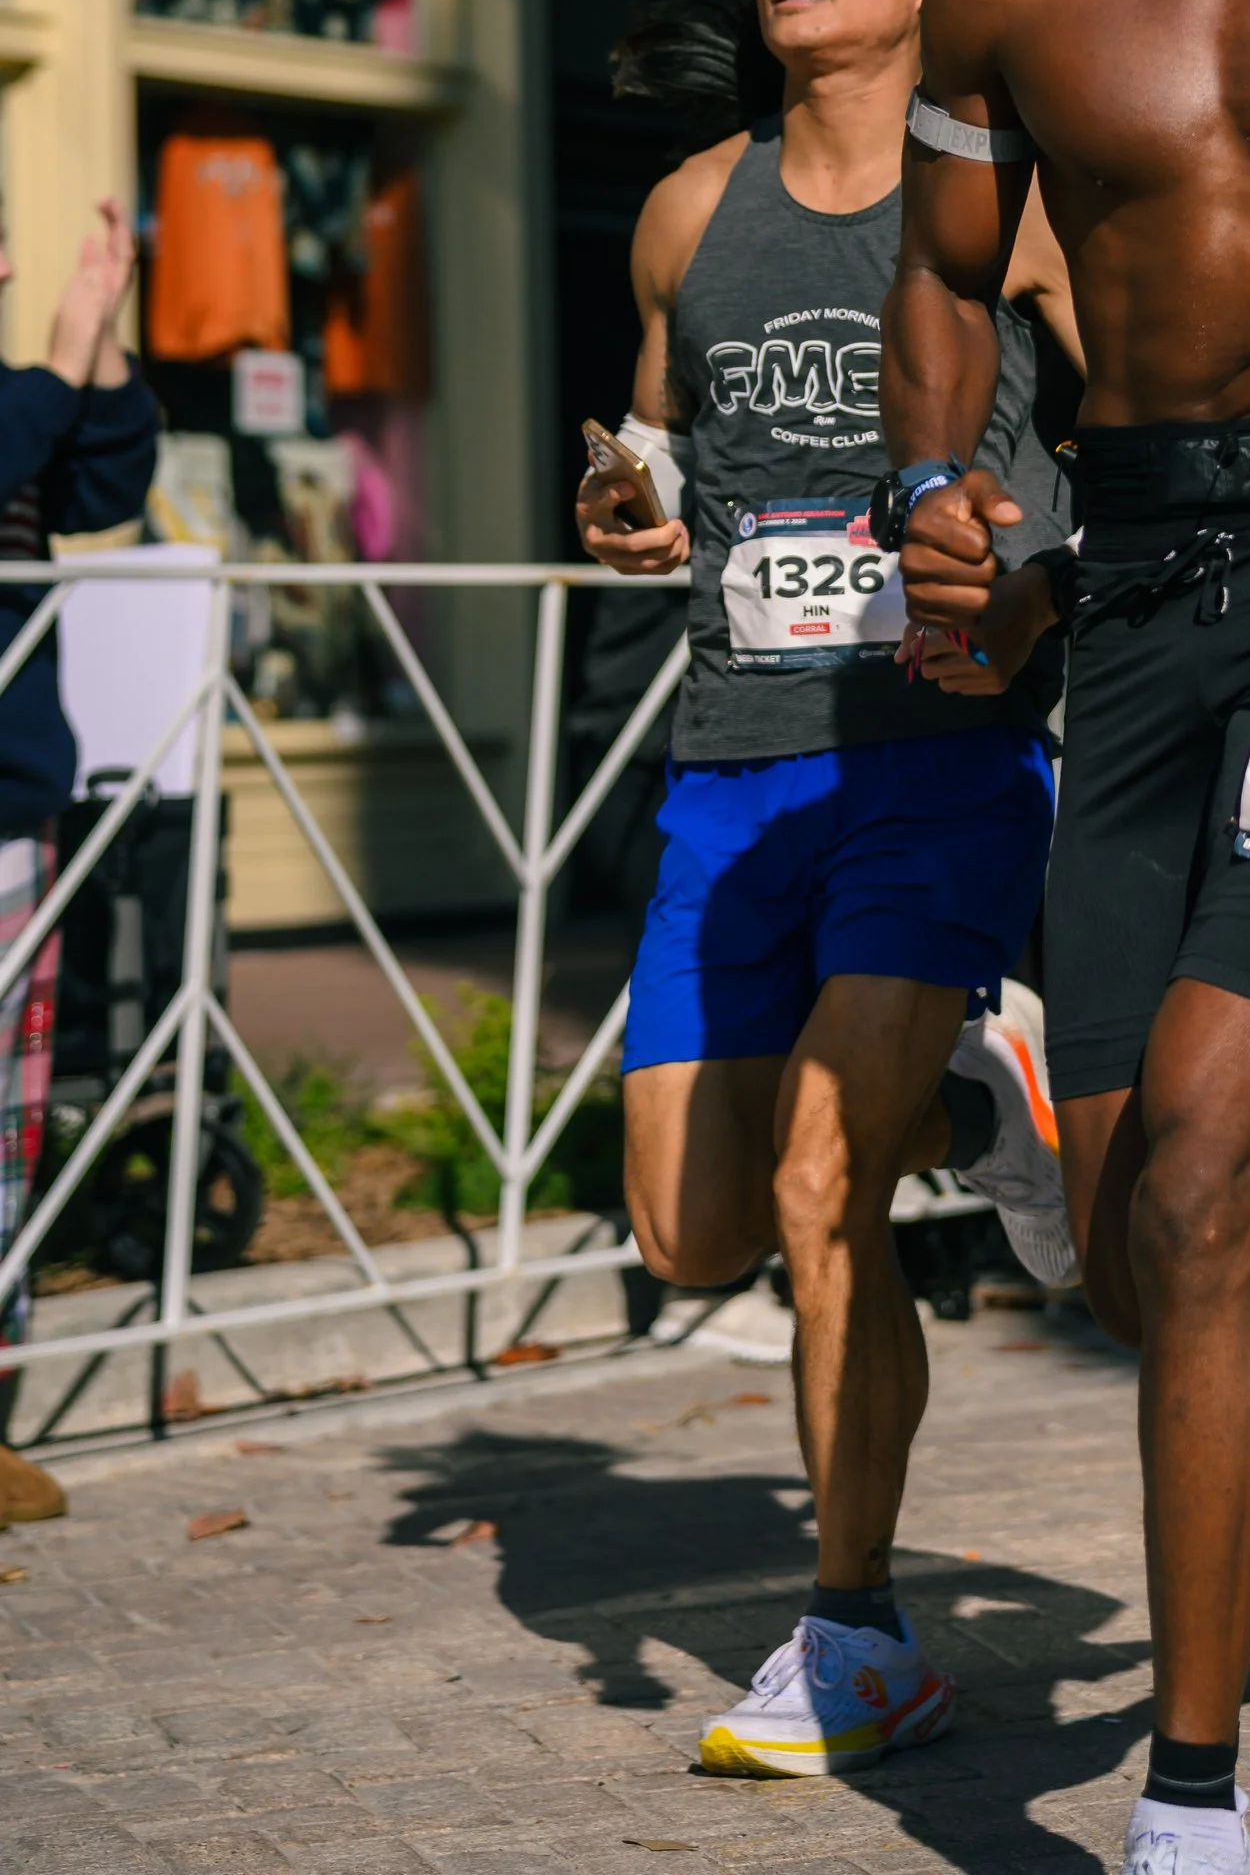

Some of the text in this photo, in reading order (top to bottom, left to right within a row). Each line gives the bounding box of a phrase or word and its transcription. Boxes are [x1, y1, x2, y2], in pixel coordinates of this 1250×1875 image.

[763, 308, 881, 334] FRIDAY MORNIN
[770, 427, 879, 449] COFFEE CLUB
[752, 553, 885, 599] 1326
[803, 605, 830, 617] HIN
[793, 625, 827, 634] CORRAL
